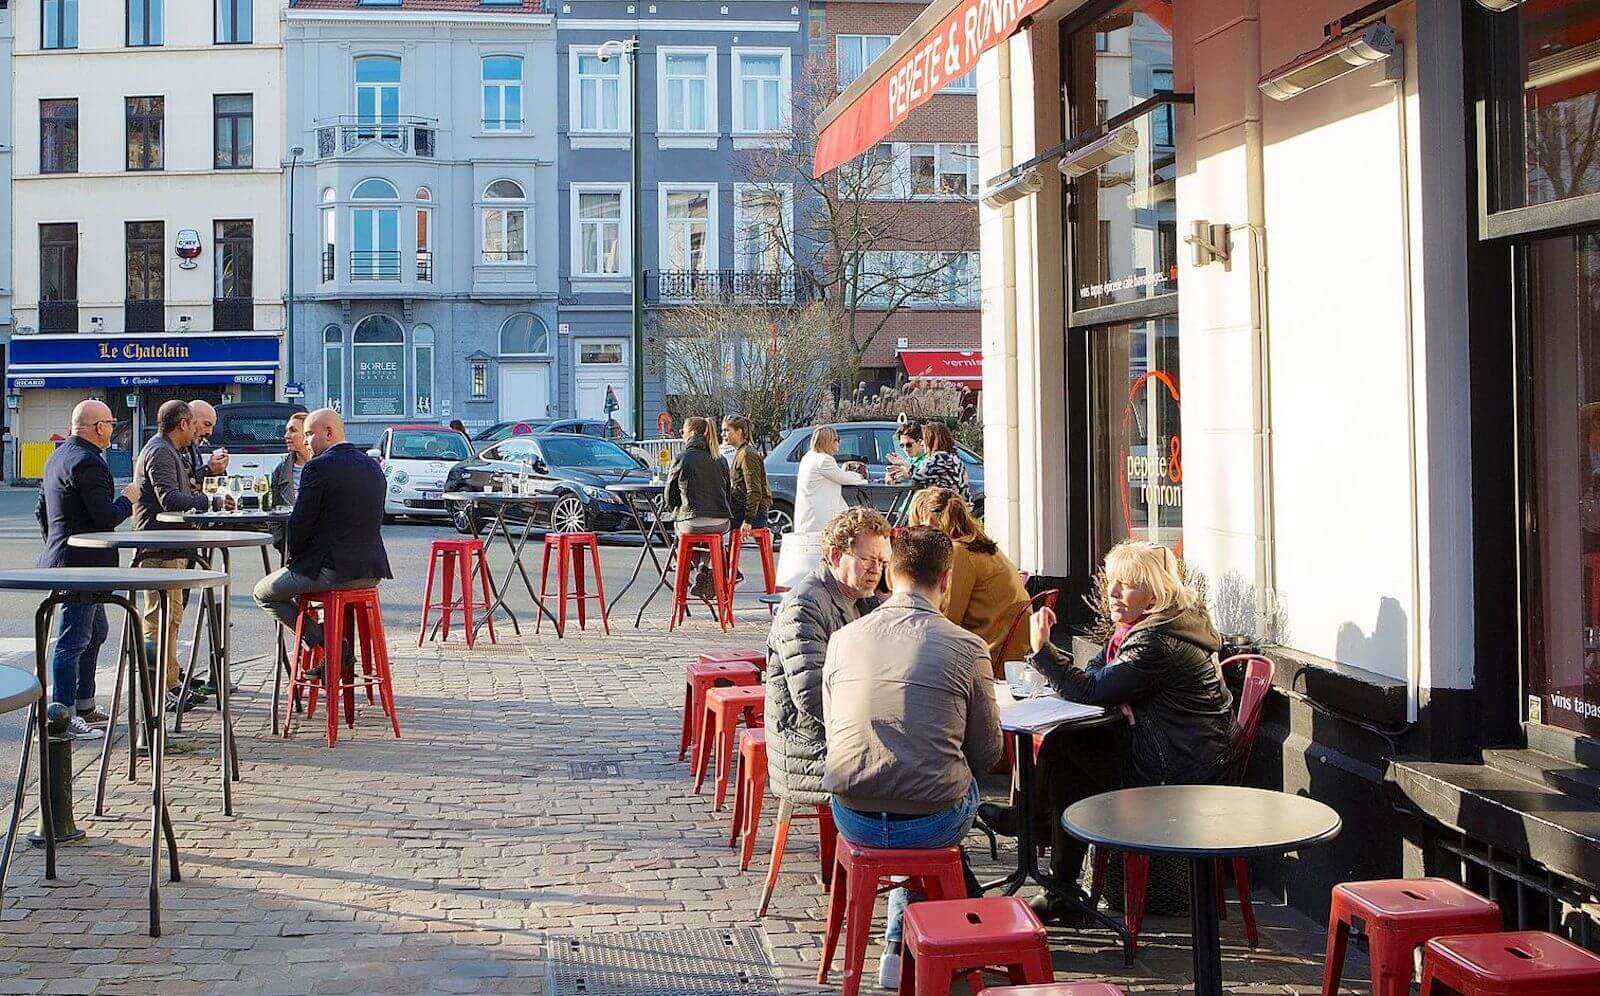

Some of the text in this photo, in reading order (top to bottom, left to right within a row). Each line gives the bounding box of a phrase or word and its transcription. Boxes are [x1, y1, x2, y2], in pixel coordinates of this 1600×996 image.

[887, 35, 943, 123] PEPETE
[944, 20, 961, 76] &
[99, 343, 189, 360] Le Chatelain
[360, 362, 397, 370] BORLEE
[1128, 436, 1182, 482] pepete &
[1141, 483, 1182, 507] ronron
[1551, 690, 1572, 711] vins
